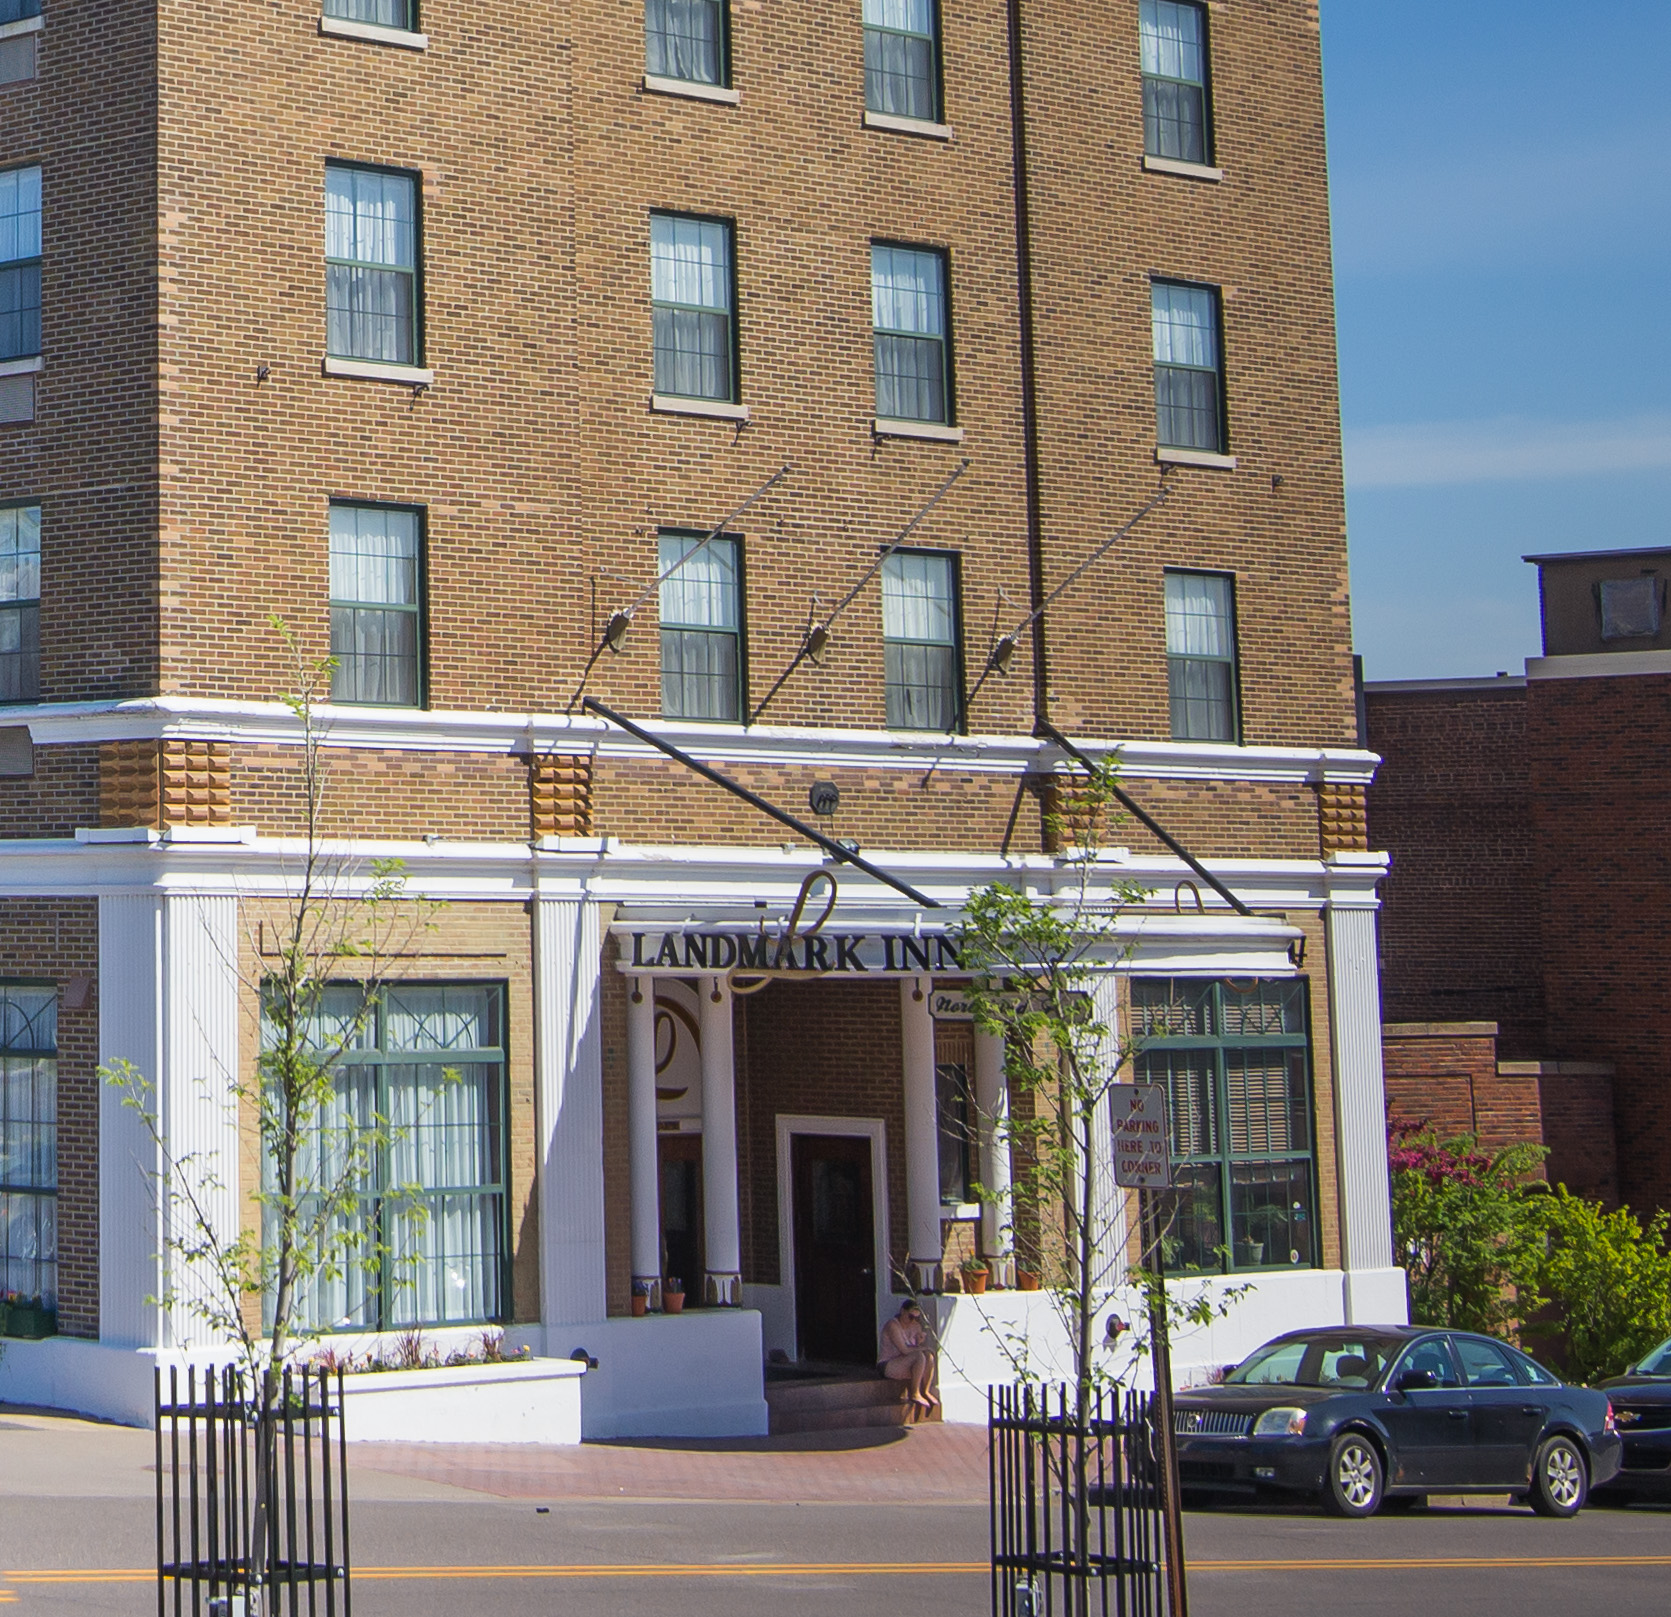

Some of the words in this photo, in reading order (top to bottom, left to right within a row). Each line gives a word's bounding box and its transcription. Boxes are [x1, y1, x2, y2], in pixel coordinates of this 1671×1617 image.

[631, 932, 869, 972] LANDMARK
[882, 933, 967, 972] INN
[1130, 1099, 1144, 1112] NO
[1116, 1118, 1159, 1134] PARKING
[1117, 1139, 1143, 1153] HERE
[1149, 1141, 1162, 1154] TO
[1122, 1159, 1162, 1175] CORNER
